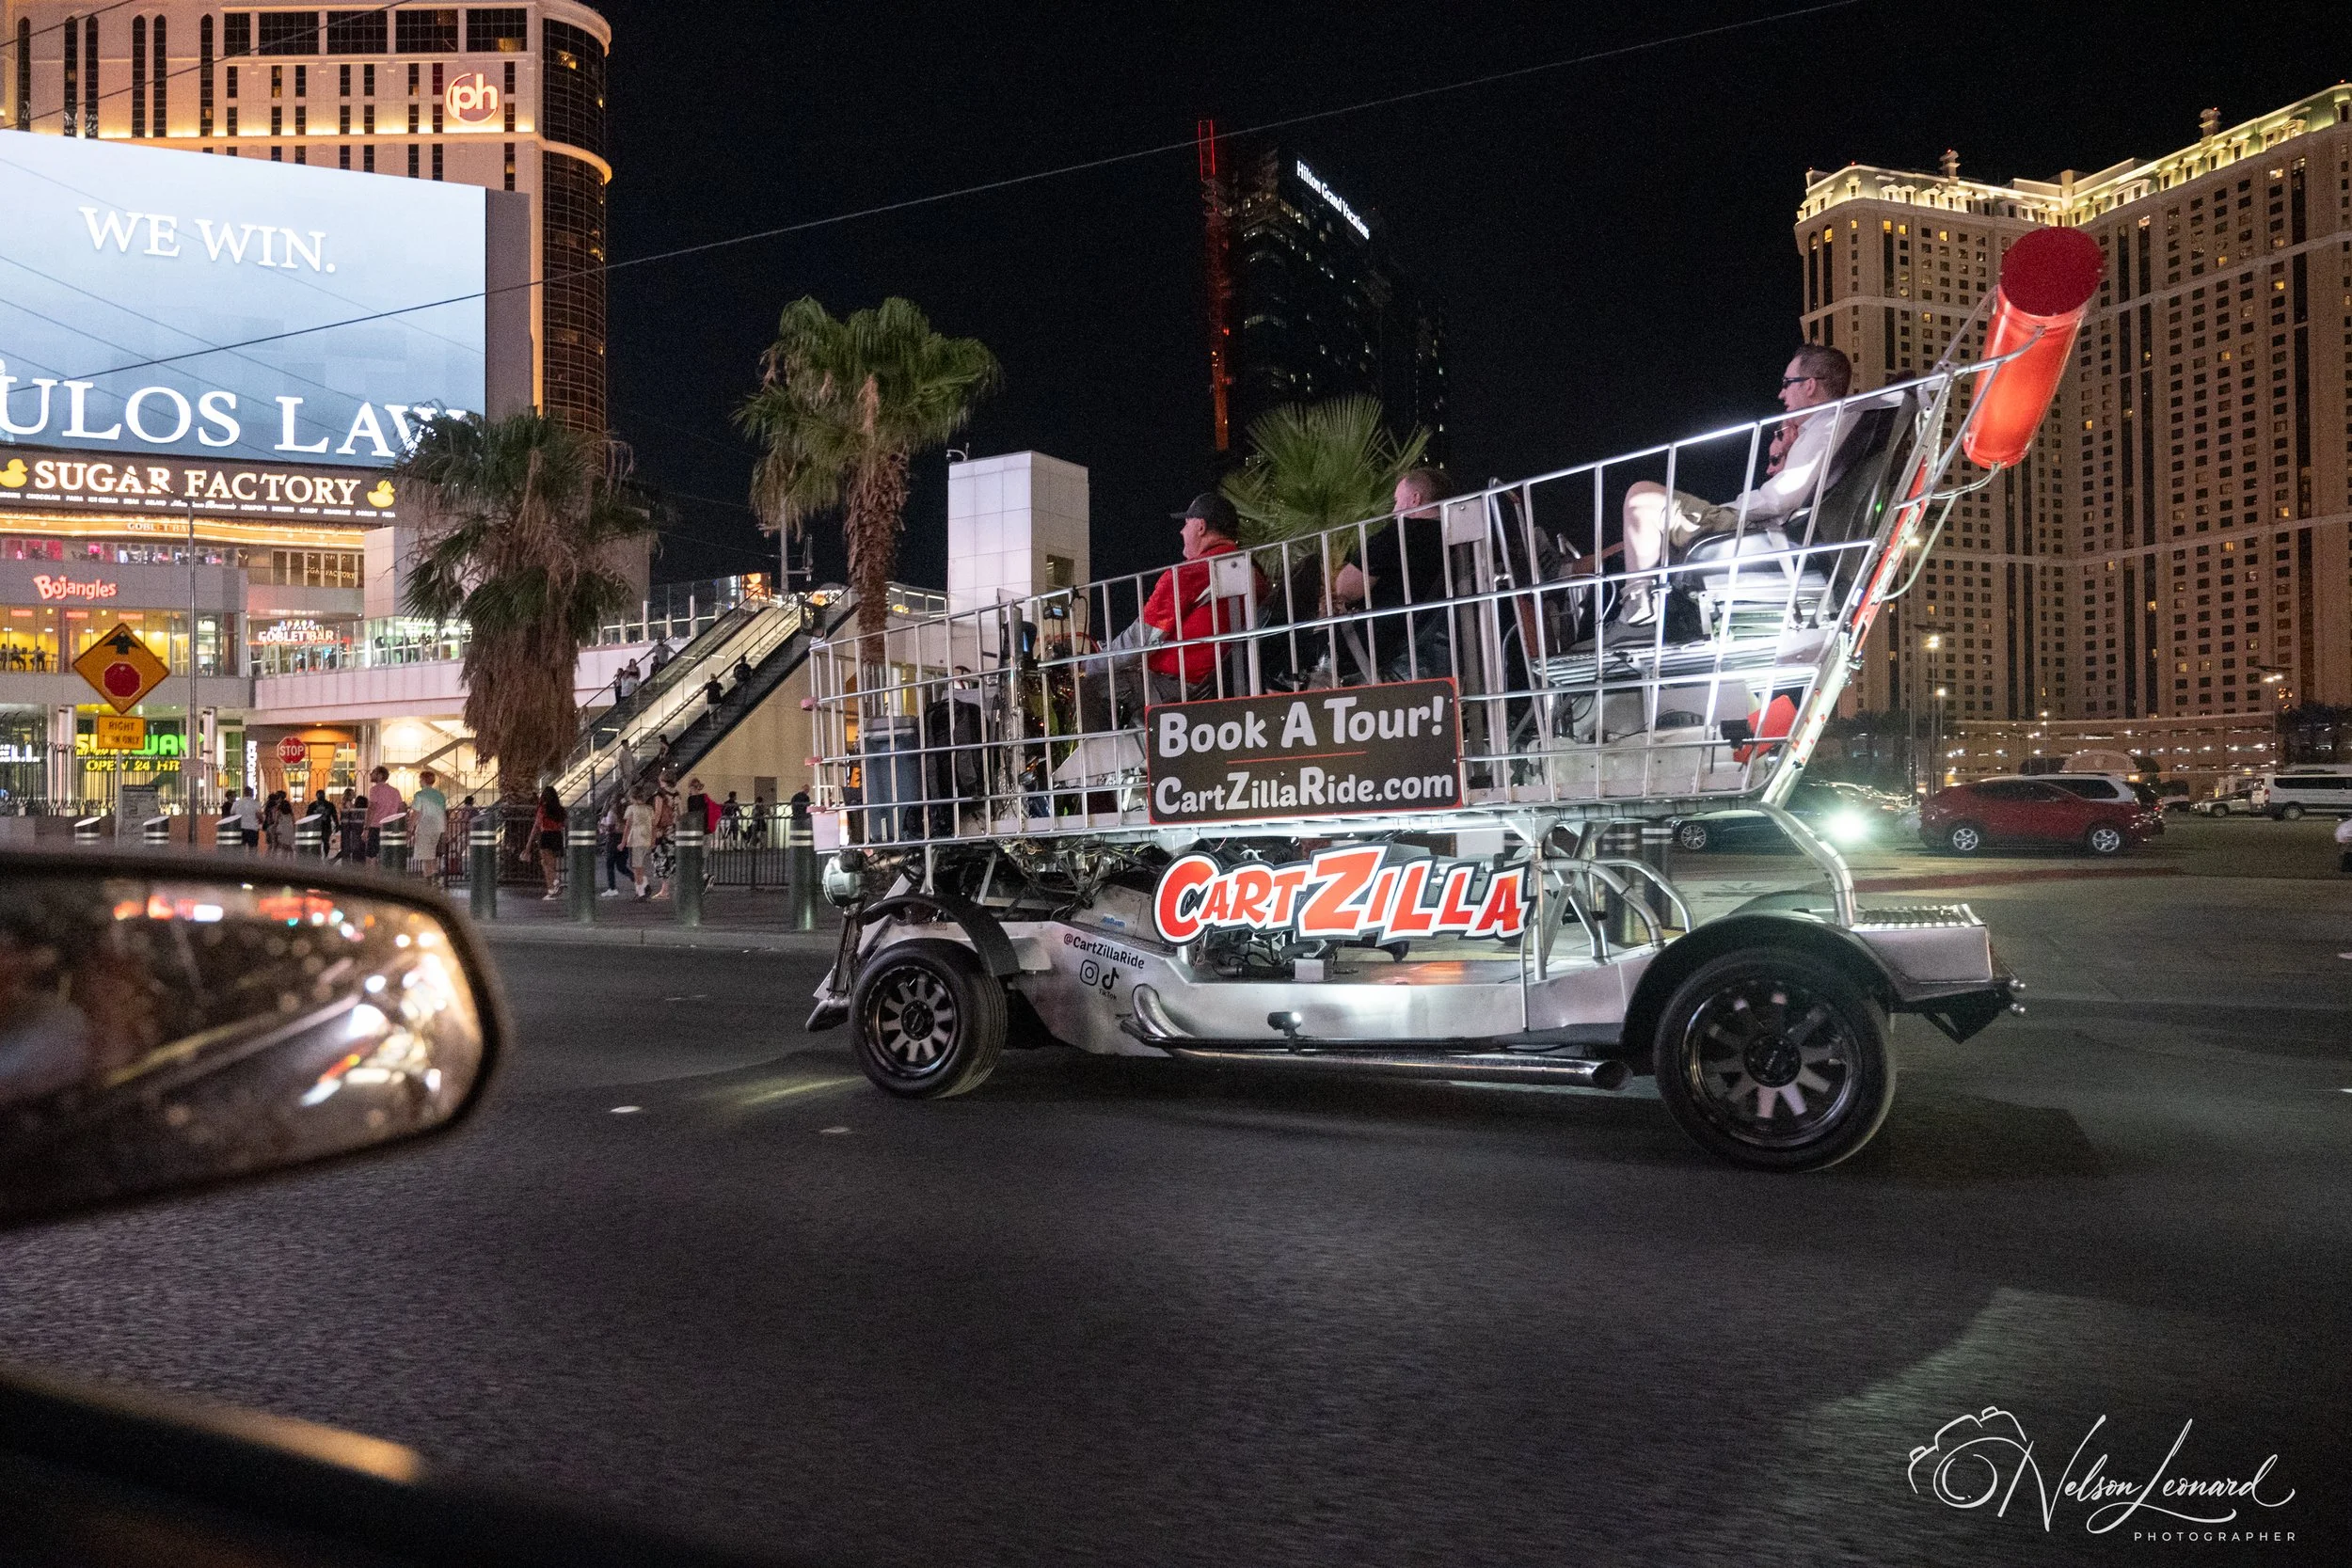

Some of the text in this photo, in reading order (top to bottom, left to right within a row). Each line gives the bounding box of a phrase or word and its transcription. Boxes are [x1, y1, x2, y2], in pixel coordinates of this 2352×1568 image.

[452, 73, 498, 119] ph
[1297, 160, 1370, 240] Hilton Grand Vacations
[79, 206, 337, 273] WE WIN.
[34, 460, 362, 505] SUGAR FACTORY
[127, 522, 169, 531] GOBLET
[33, 575, 118, 600] Bojangles
[258, 629, 334, 642] GOBLET BAR
[108, 721, 135, 731] RIGHT
[122, 736, 140, 745] ONLY
[1157, 695, 1445, 758] Book A Tour!
[134, 760, 150, 771] 24
[279, 747, 305, 757] STOP
[1155, 767, 1454, 816] CartZillaRide.com
[1064, 933, 1145, 970] @CartZillaRide
